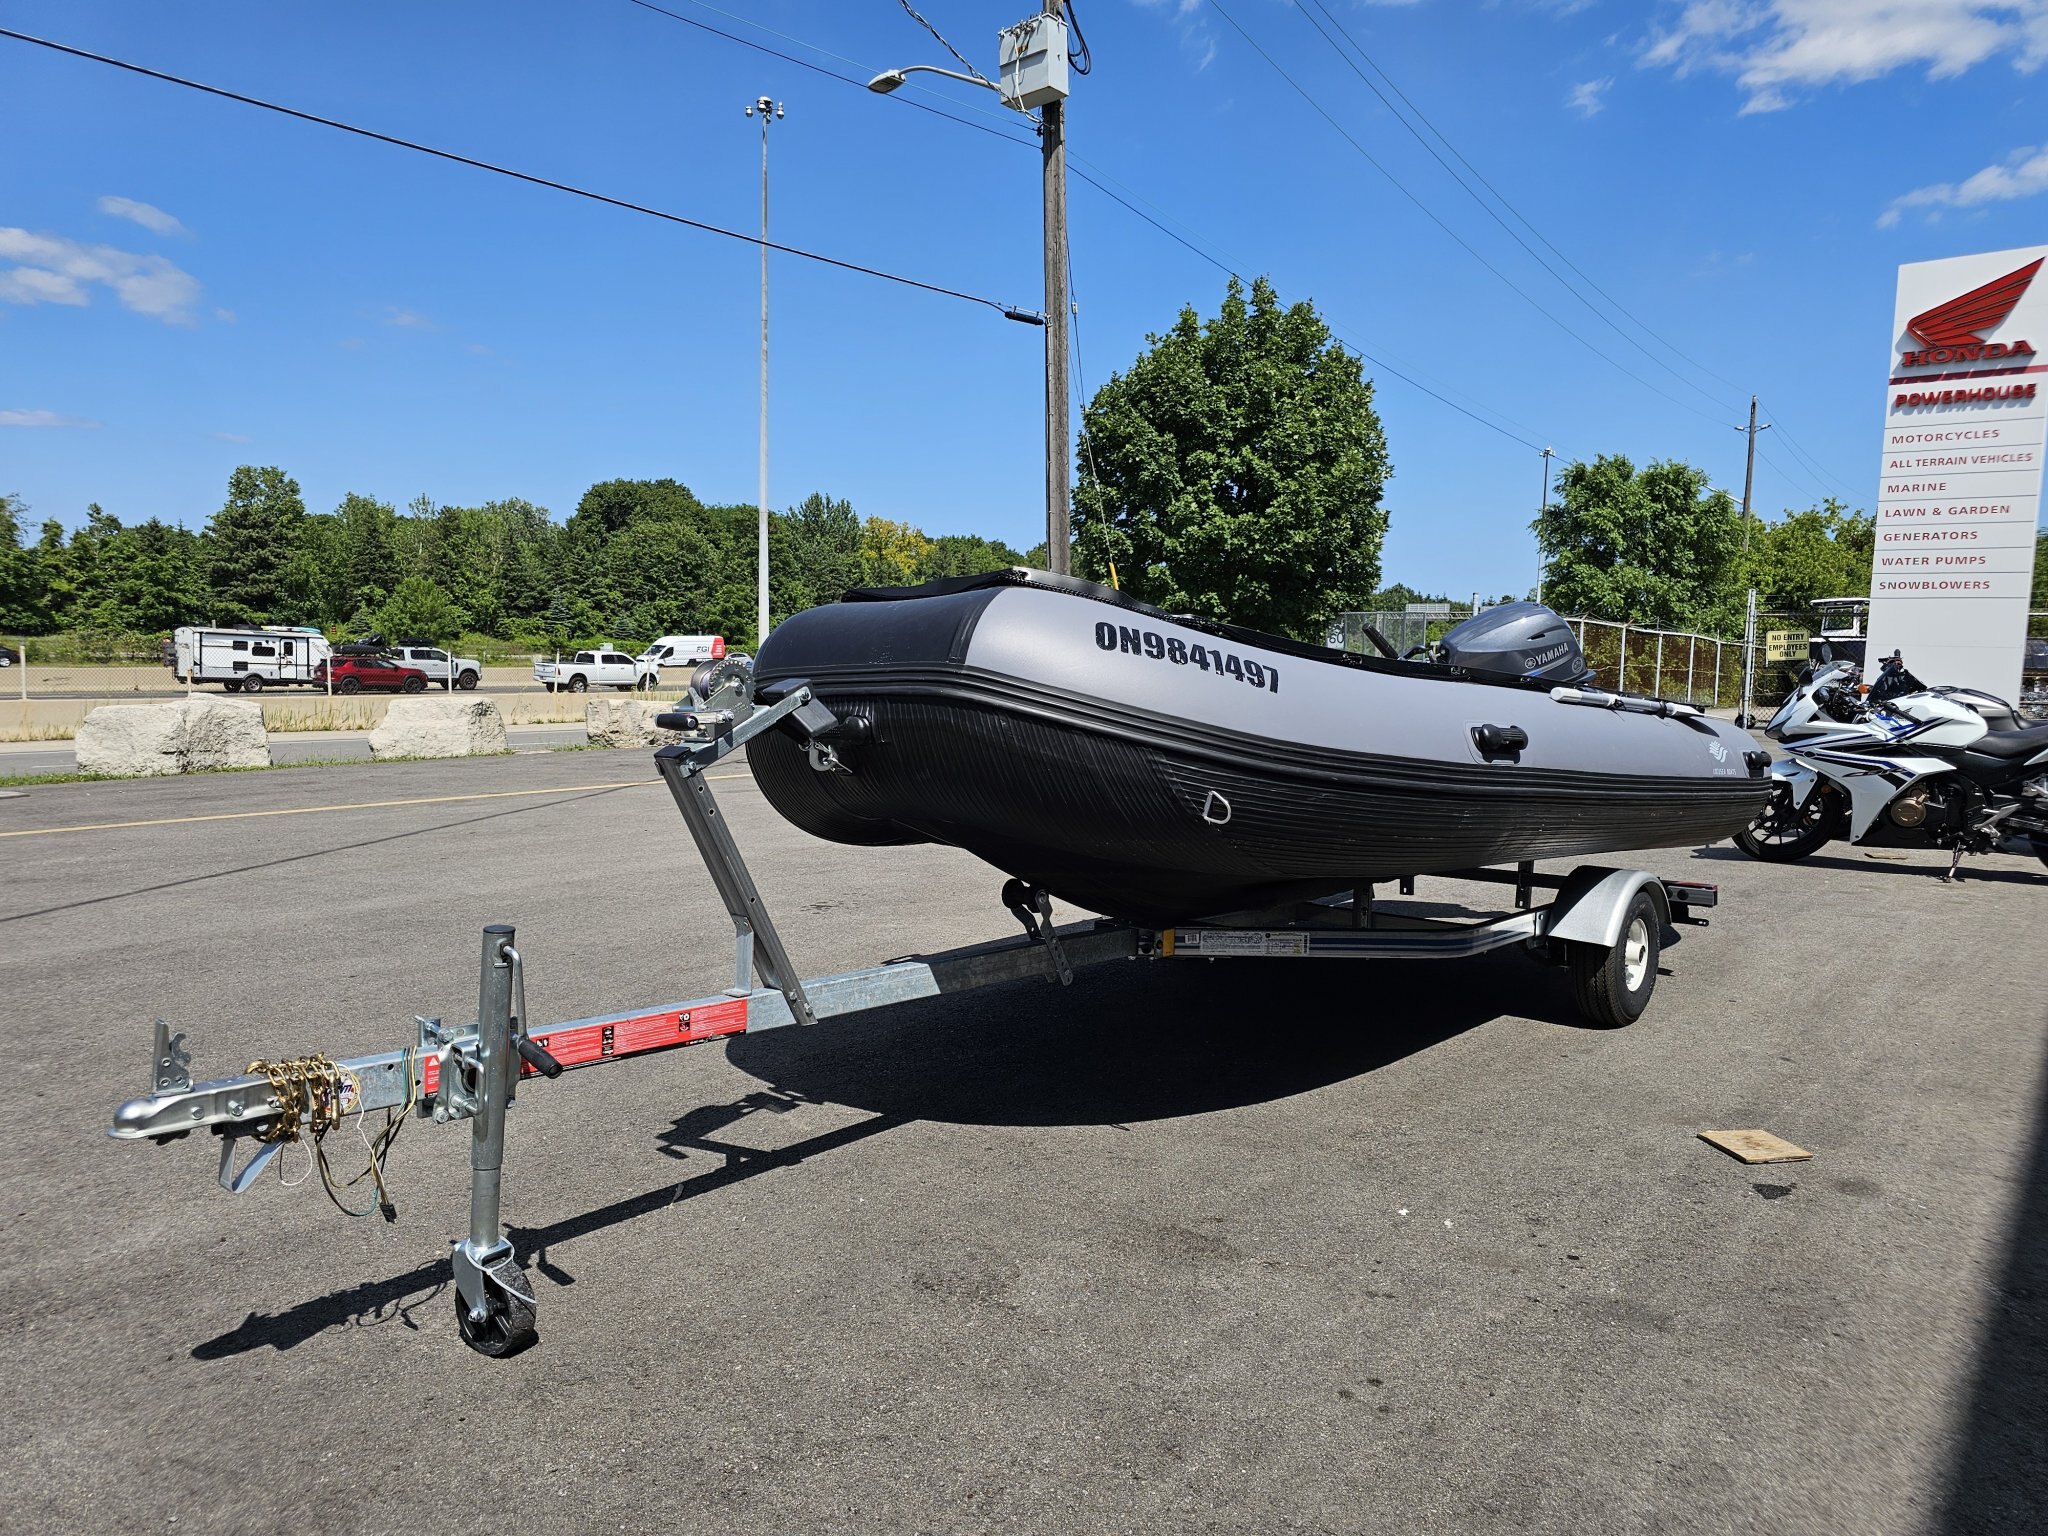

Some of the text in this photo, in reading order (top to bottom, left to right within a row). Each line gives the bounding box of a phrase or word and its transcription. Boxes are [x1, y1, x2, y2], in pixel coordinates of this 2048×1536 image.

[1902, 340, 2037, 368] HONDA
[1895, 384, 2037, 408] POWERHOUSE
[1891, 429, 2000, 444] MOTORCYCLES
[1890, 453, 2033, 469] ALL TERRAIN VEHICLES
[1887, 482, 1947, 493] MARINE
[1885, 505, 2011, 518] LAWN & GARDEN
[1883, 531, 1978, 542] GENERATORS
[1882, 556, 1986, 566] WATER PUMPS
[1879, 581, 1991, 590] SNOWBLOWERS
[1783, 633, 1805, 641] ENTRY
[1535, 642, 1569, 665] YAMAHA
[1769, 643, 1808, 651] EMPLOYEES
[1095, 621, 1279, 693] ON9841497
